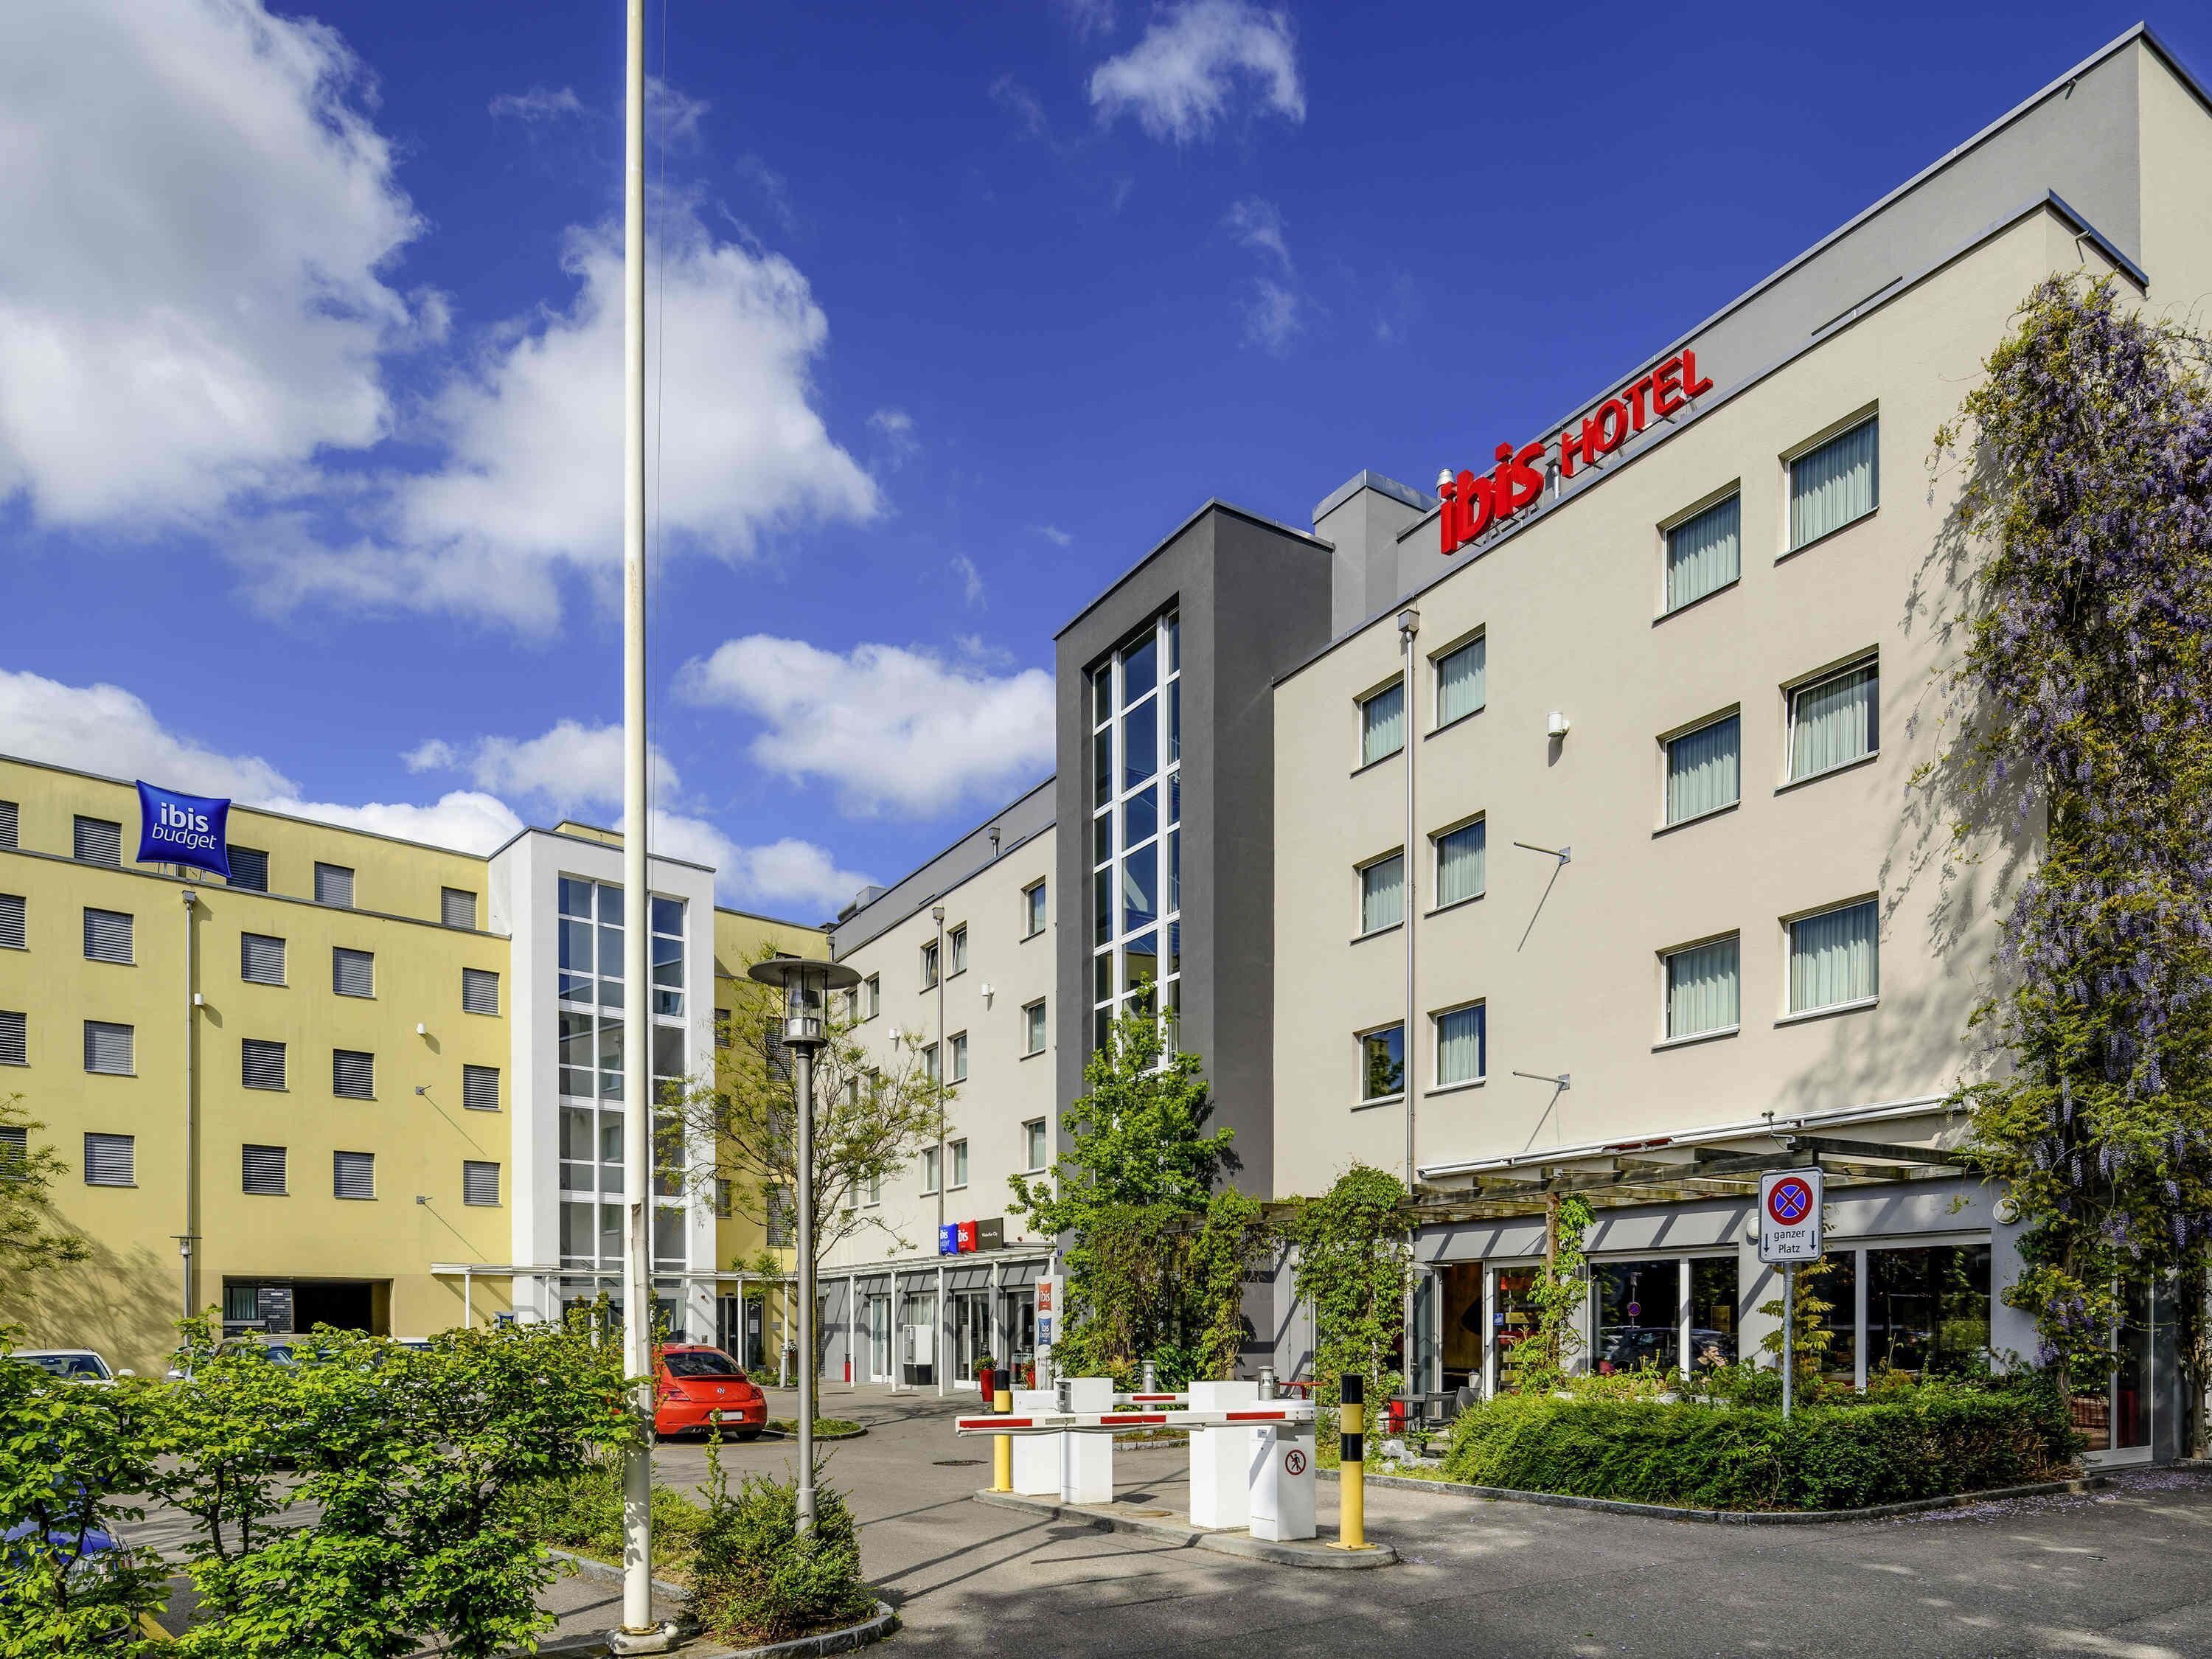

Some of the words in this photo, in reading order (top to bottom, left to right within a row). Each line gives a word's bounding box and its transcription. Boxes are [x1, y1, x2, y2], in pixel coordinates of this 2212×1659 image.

[1441, 442, 1545, 555] ibis
[1561, 348, 1714, 479] HOTEL
[161, 801, 209, 832] ibis
[152, 822, 218, 849] budget
[1773, 1229, 1806, 1242] ganzer
[1778, 1243, 1801, 1253] Platz
[1040, 1290, 1050, 1302] ibis
